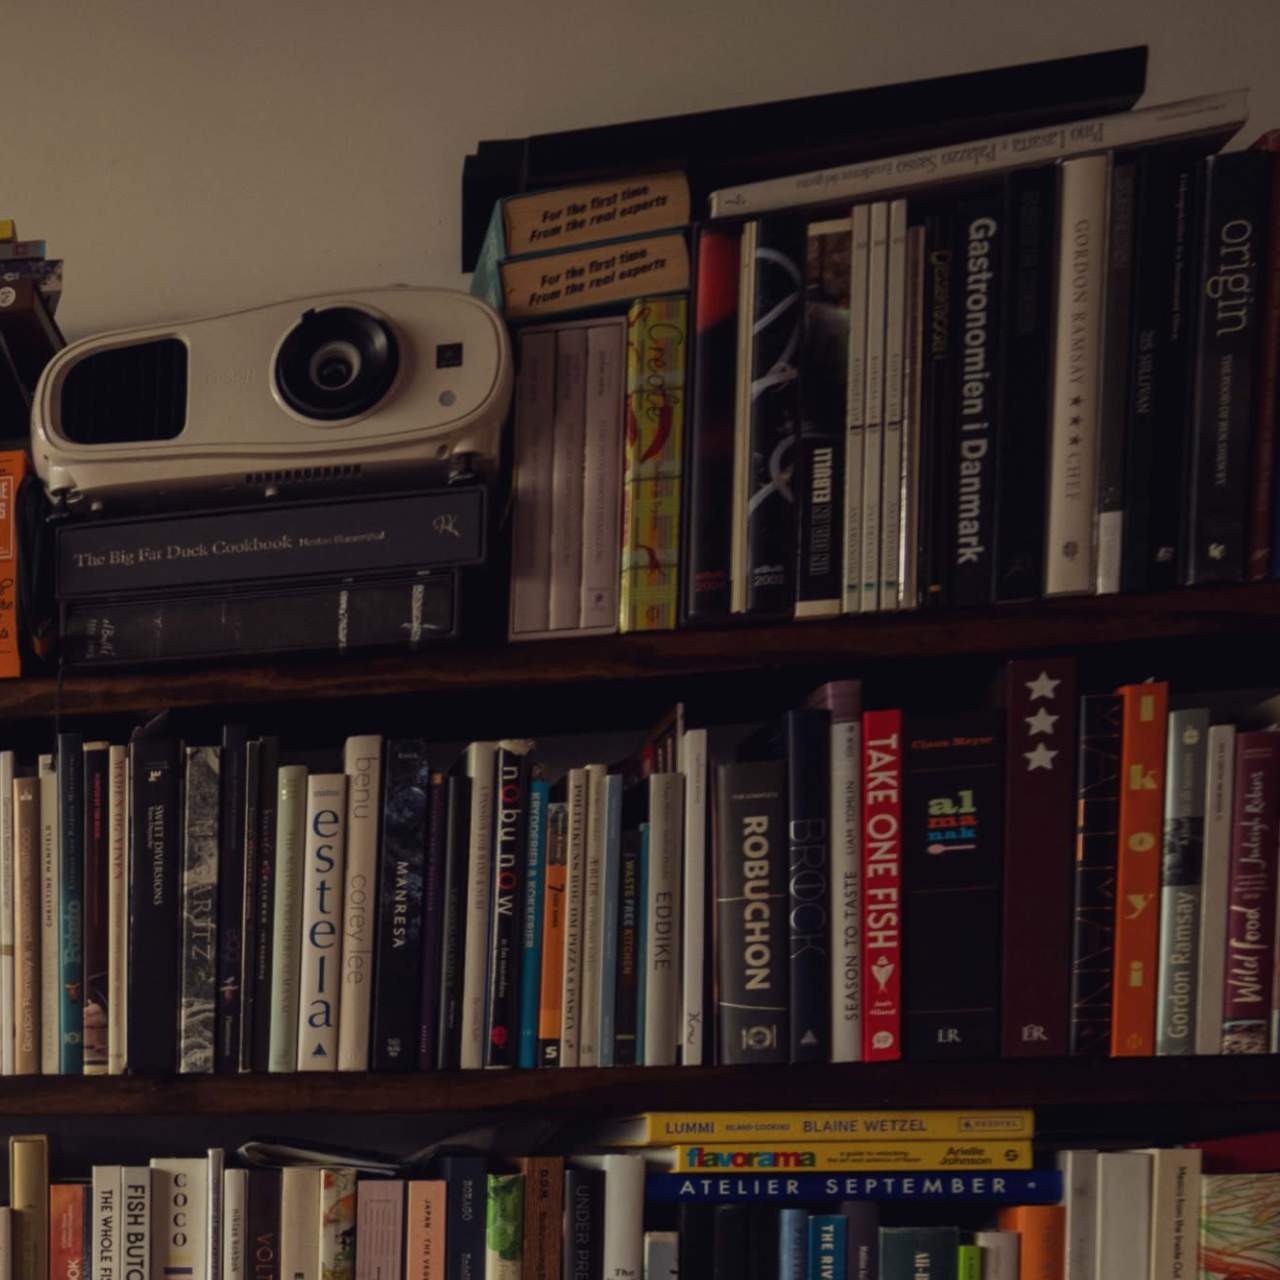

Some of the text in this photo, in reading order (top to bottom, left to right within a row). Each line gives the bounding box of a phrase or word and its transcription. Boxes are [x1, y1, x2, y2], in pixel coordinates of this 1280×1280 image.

[541, 184, 649, 224] For the first time
[540, 246, 647, 288] For the first time
[1206, 218, 1255, 338] origin
[960, 217, 998, 415] Gastronomien
[1064, 219, 1090, 501] GORDON RAMSAY CHEF
[812, 449, 833, 505] ELBULLI
[956, 438, 990, 564] Danmark
[501, 766, 520, 842] nobu
[151, 805, 164, 906] SWEET DIVERSIONS
[346, 757, 378, 985] benu corey lee
[867, 734, 899, 949] TAKE ONE FISH
[392, 861, 409, 949] MANRESA
[498, 854, 517, 916] now
[742, 815, 771, 991] ROBUCHON
[307, 806, 339, 1029] estela
[654, 891, 673, 972] EDDIKE
[1167, 892, 1197, 1039] Gordon Ramsay
[665, 1120, 715, 1135] LUMMI
[802, 1119, 859, 1134] BLAINE
[863, 1118, 928, 1133] WETZEL
[679, 1177, 1007, 1196] ATELIER SEPTEMBER
[687, 1147, 816, 1169] flavorama
[939, 1155, 992, 1167] Johnson
[100, 1189, 113, 1213] THE
[126, 1184, 146, 1226] FISH
[423, 1198, 432, 1229] JAPAN
[574, 1184, 591, 1245] UNDER
[100, 1216, 113, 1262] WHOLE
[422, 1237, 431, 1256] THE
[820, 1224, 835, 1251] THE
